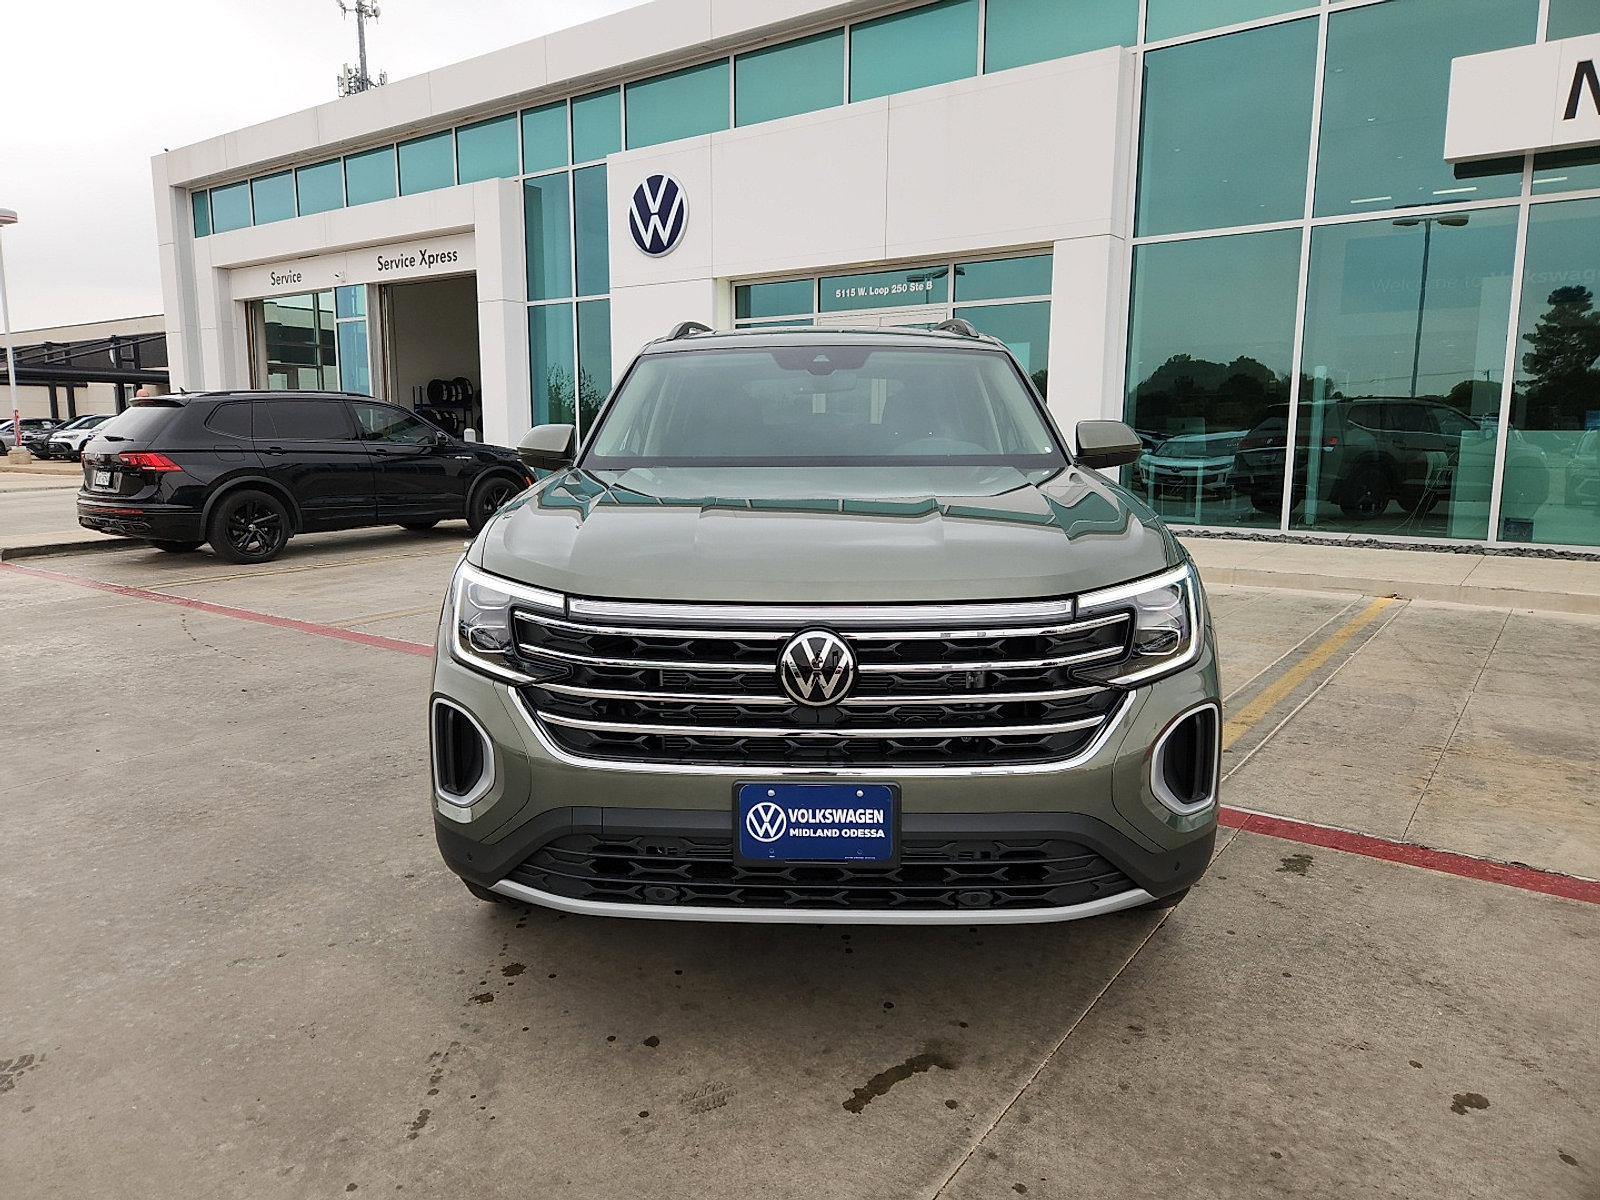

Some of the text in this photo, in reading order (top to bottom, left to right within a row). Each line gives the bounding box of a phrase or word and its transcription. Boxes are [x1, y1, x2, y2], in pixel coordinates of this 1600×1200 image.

[377, 248, 458, 272] Service Xpress
[270, 269, 302, 287] Service
[835, 280, 933, 298] 5115 W. Loop 250 Ste B
[787, 808, 884, 824] VOLKSWAGEN
[789, 828, 886, 838] MIDLAND ODESSA
